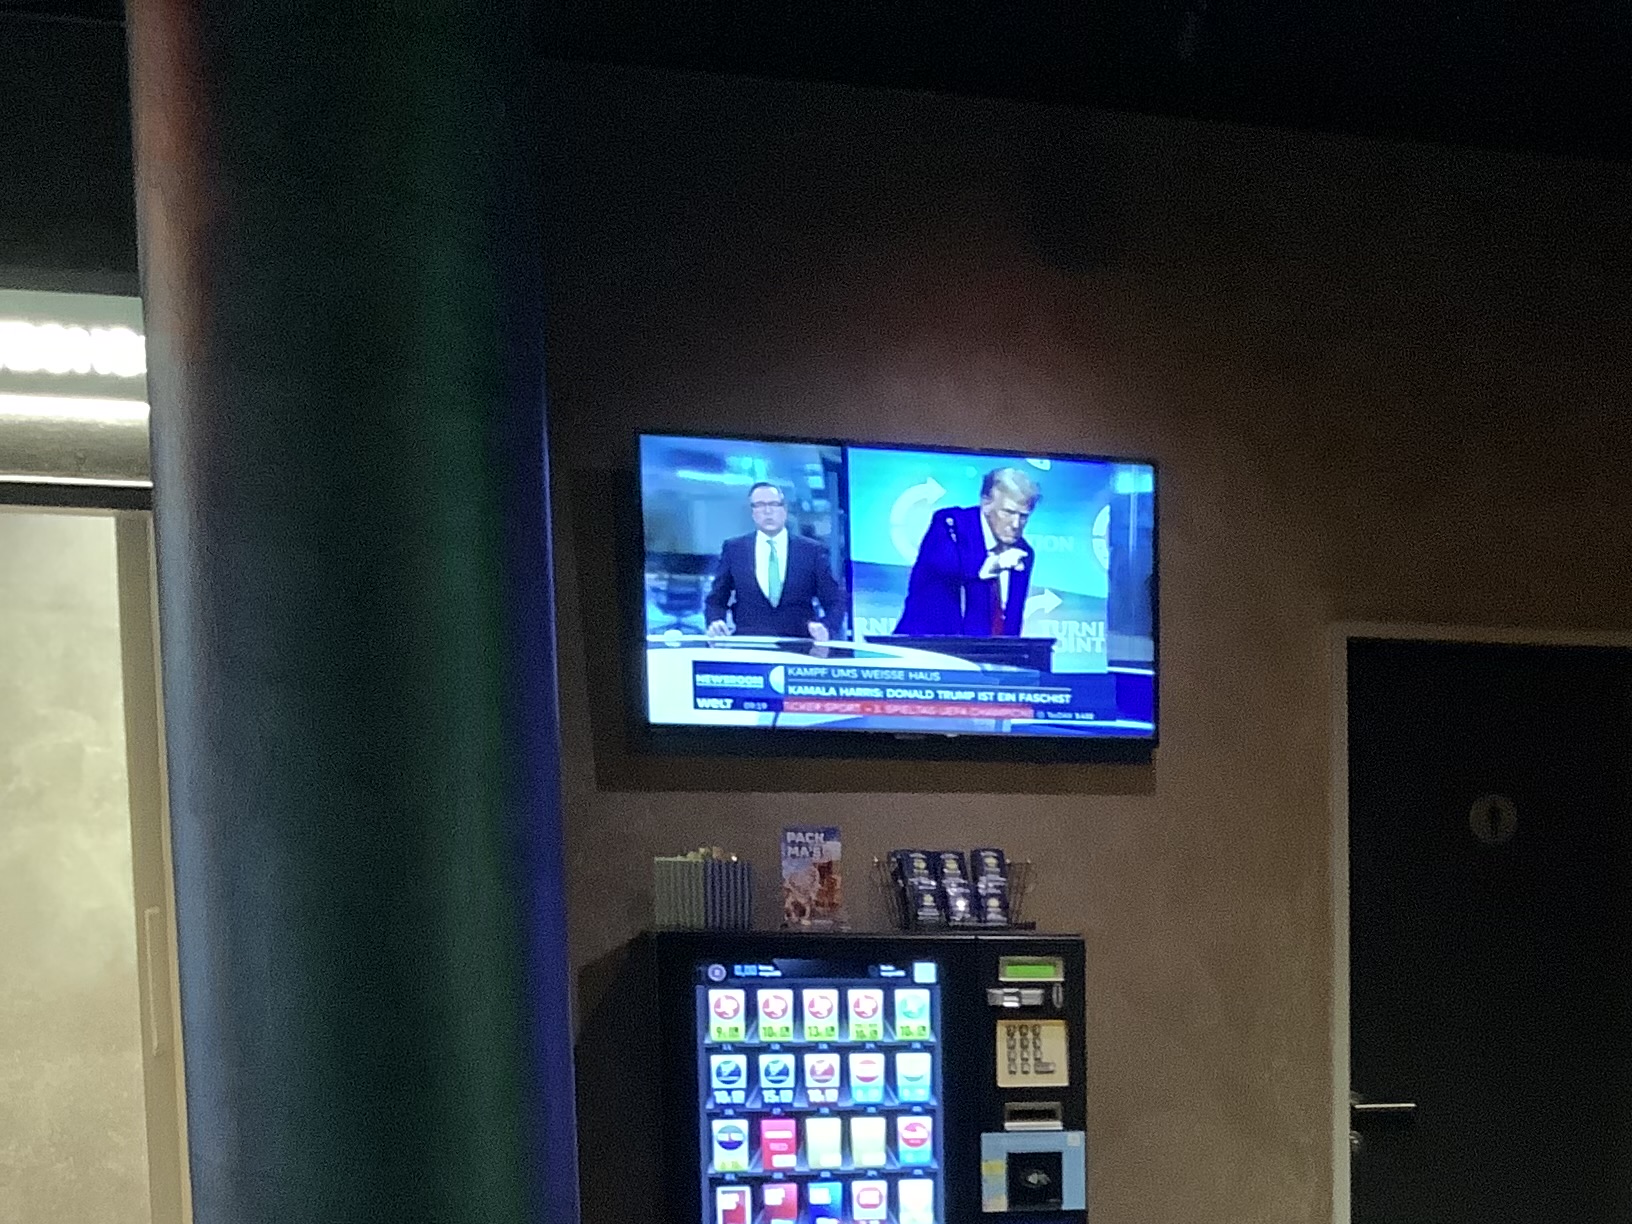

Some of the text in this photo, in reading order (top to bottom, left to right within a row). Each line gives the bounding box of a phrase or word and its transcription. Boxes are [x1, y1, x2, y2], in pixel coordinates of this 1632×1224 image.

[788, 668, 941, 682] KAMPF UMS WEISSE HAUS
[788, 685, 1072, 705] KAMALA HARRIS: DONALD TRUMP IST EIN FASCHIST
